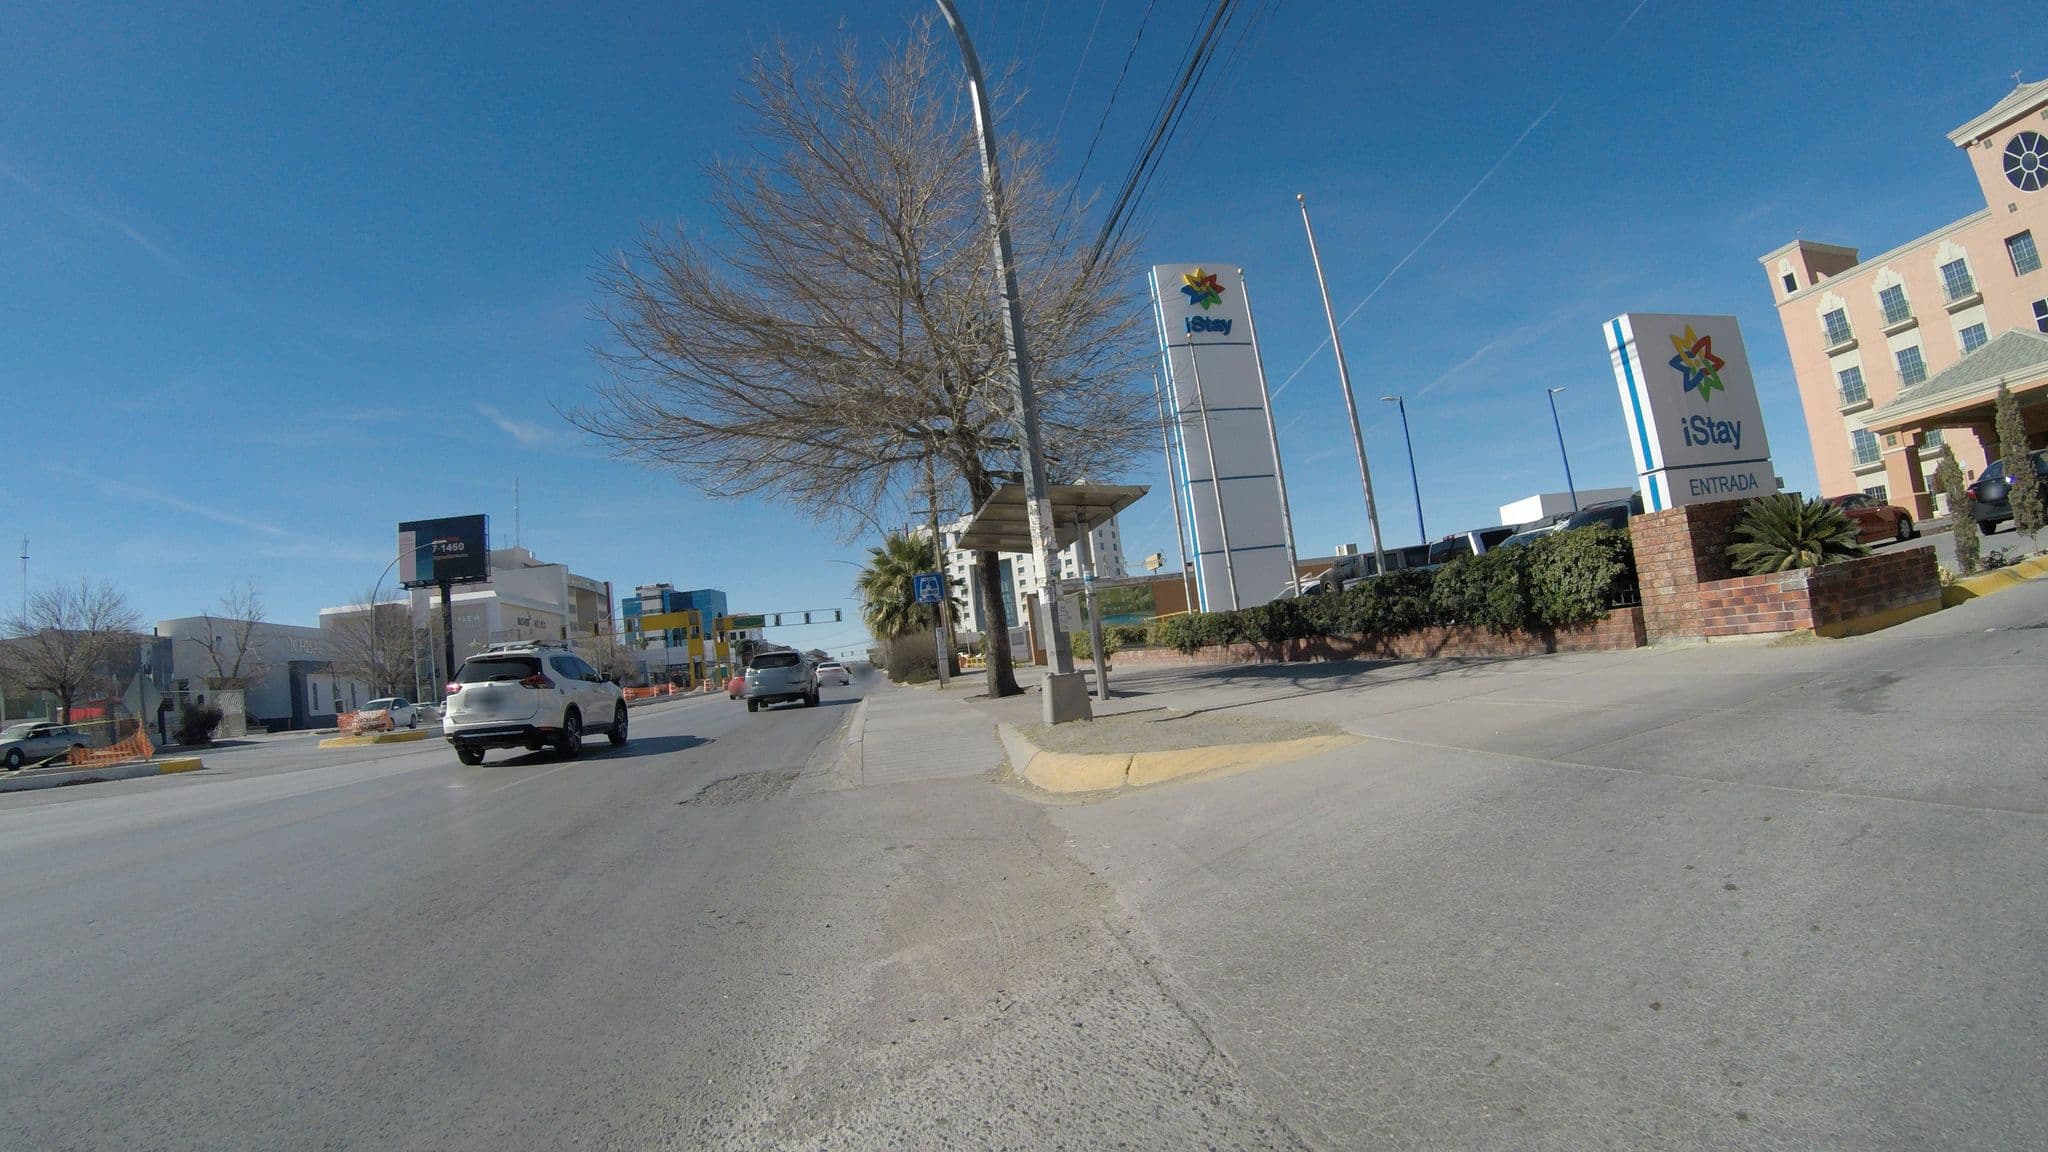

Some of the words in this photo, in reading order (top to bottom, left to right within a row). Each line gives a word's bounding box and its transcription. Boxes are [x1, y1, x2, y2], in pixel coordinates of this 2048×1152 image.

[1185, 316, 1232, 336] iStay
[1681, 415, 1741, 450] iStay
[1689, 473, 1759, 497] ENTRADA
